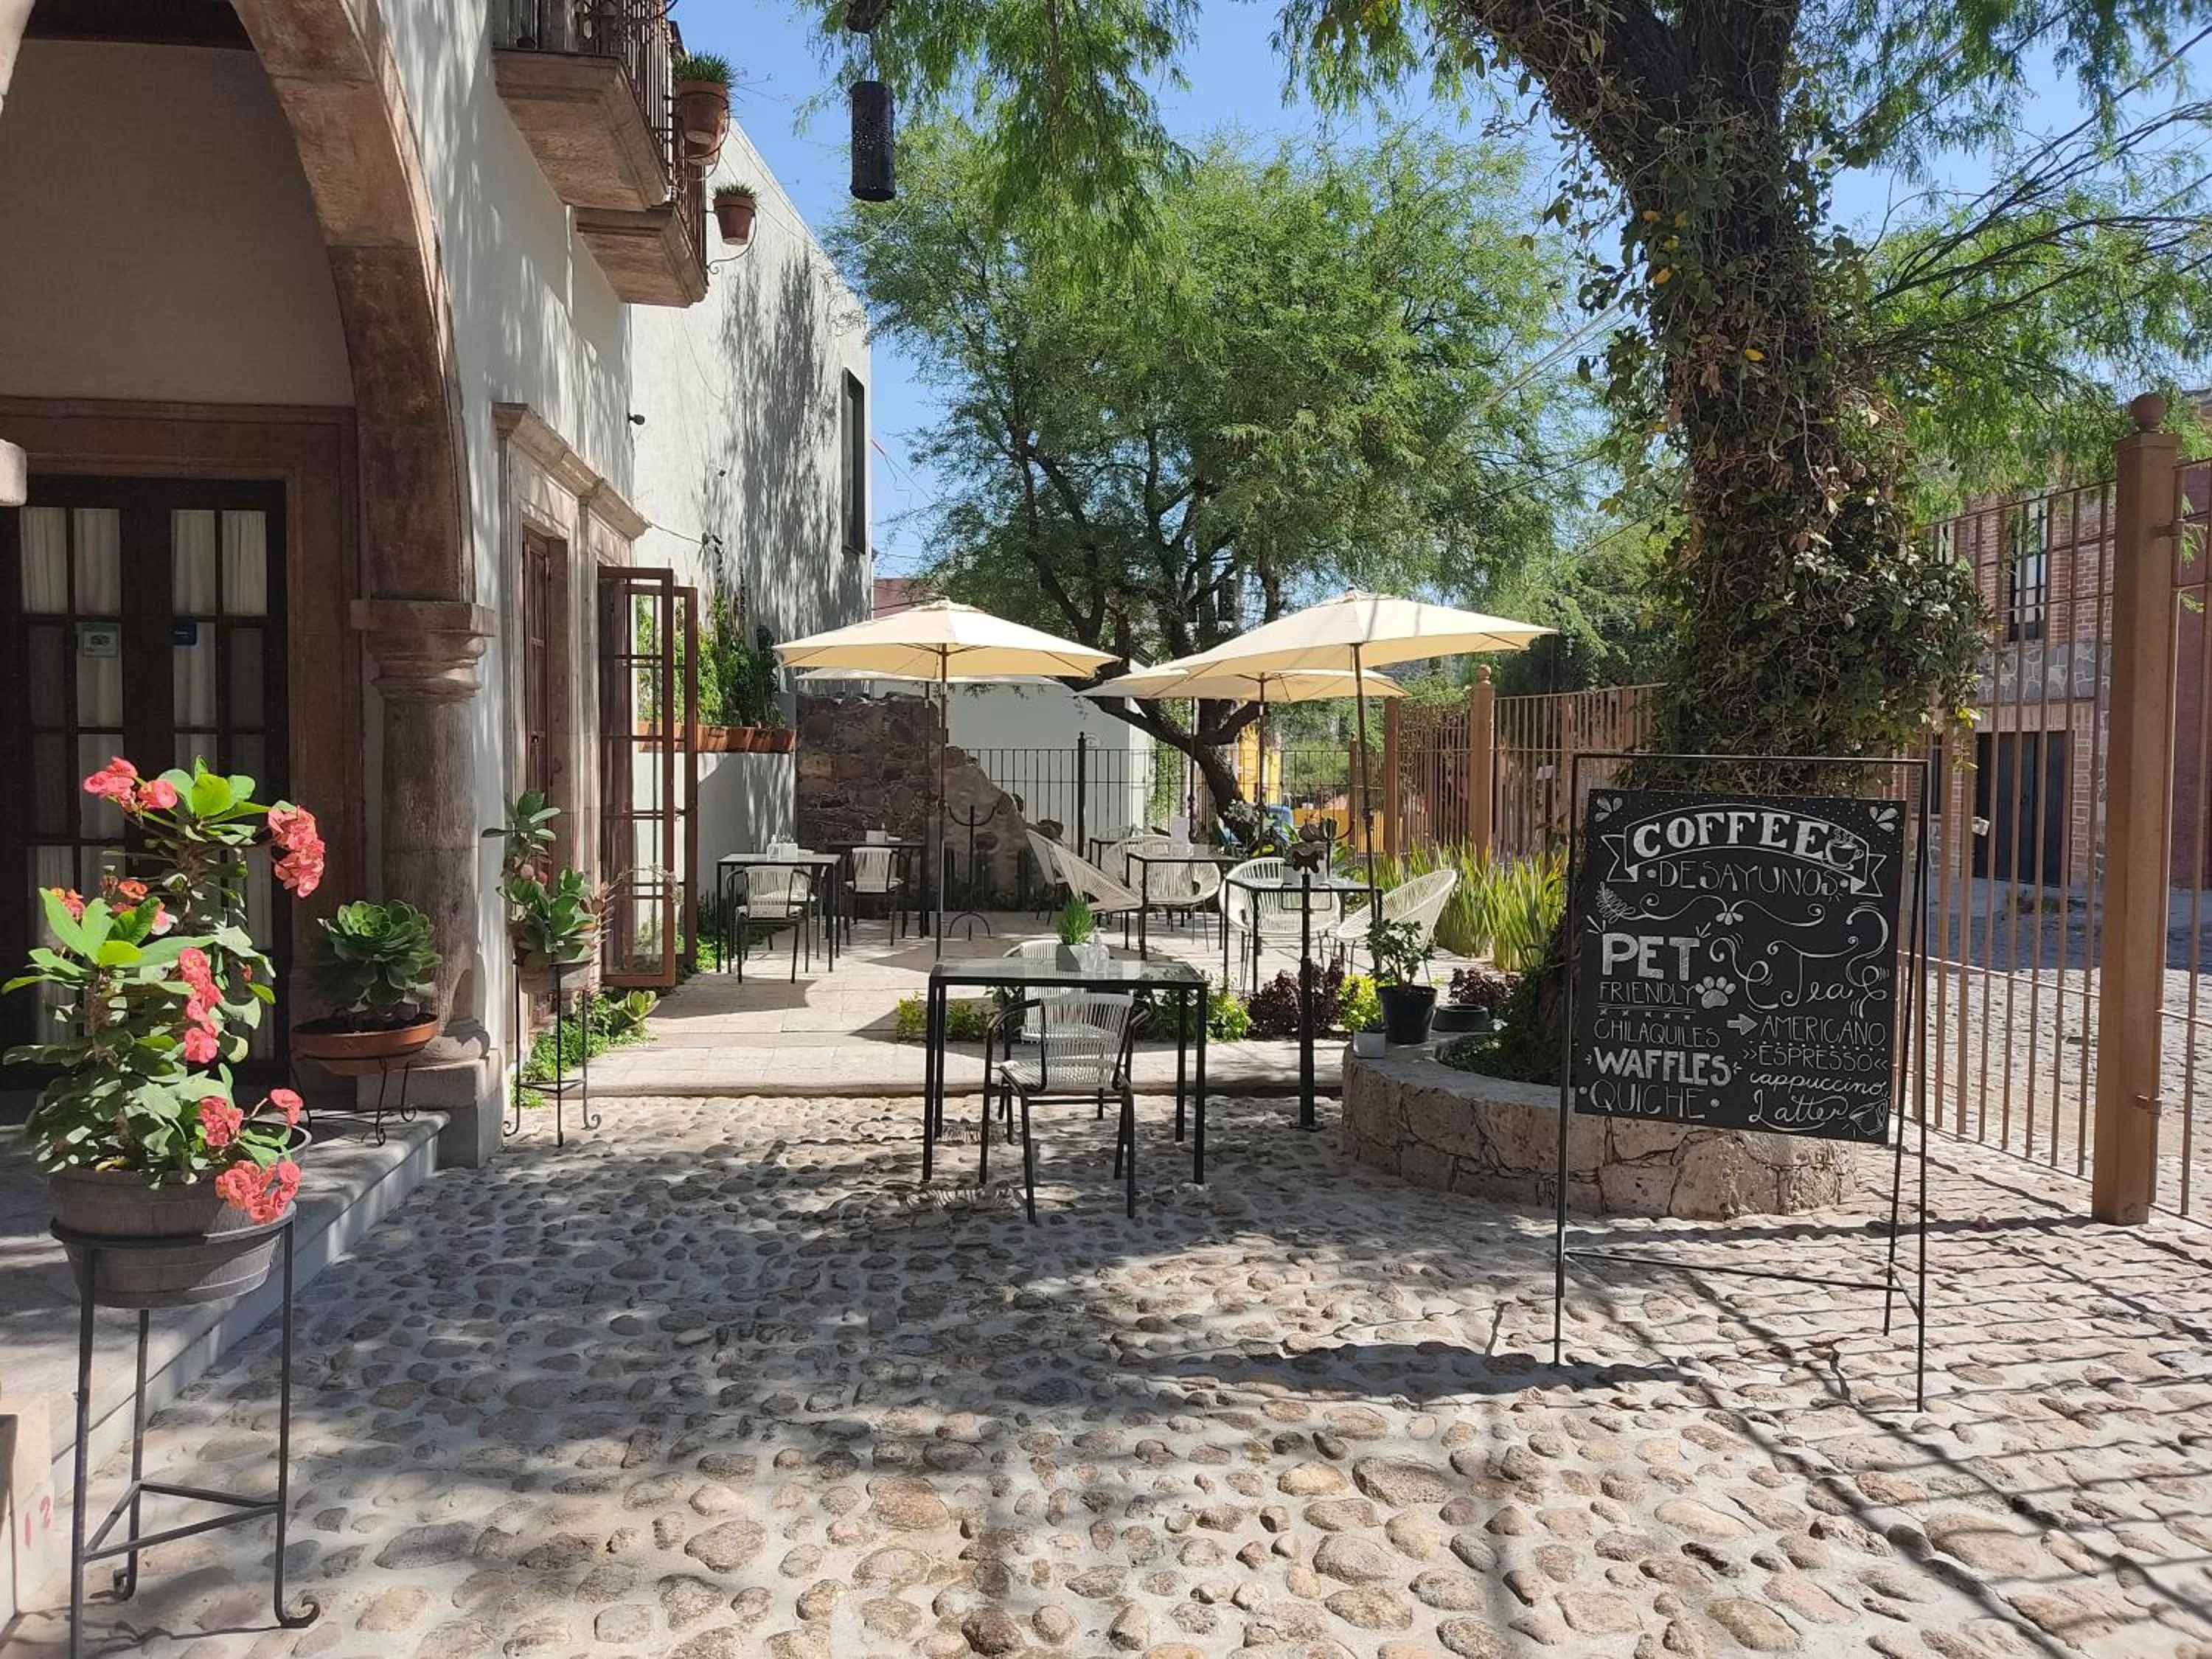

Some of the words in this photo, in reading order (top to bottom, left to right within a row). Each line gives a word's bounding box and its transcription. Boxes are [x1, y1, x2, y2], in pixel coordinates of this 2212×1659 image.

[1632, 812, 1829, 860] COFFEE
[1660, 860, 1838, 896] DESAYUNOS
[1602, 933, 1700, 981] PET
[1767, 936, 1859, 1006] Tea
[1599, 981, 1696, 1005] FRIENDLY
[1593, 1018, 1720, 1048] CHILAQUILES
[1760, 1015, 1885, 1046] AMERICANO
[1593, 1047, 1731, 1086] WAFFLES
[1759, 1046, 1873, 1071] ESPRESSO
[1590, 1079, 1707, 1119] QUICHE
[1750, 1072, 1887, 1095] cappuccino
